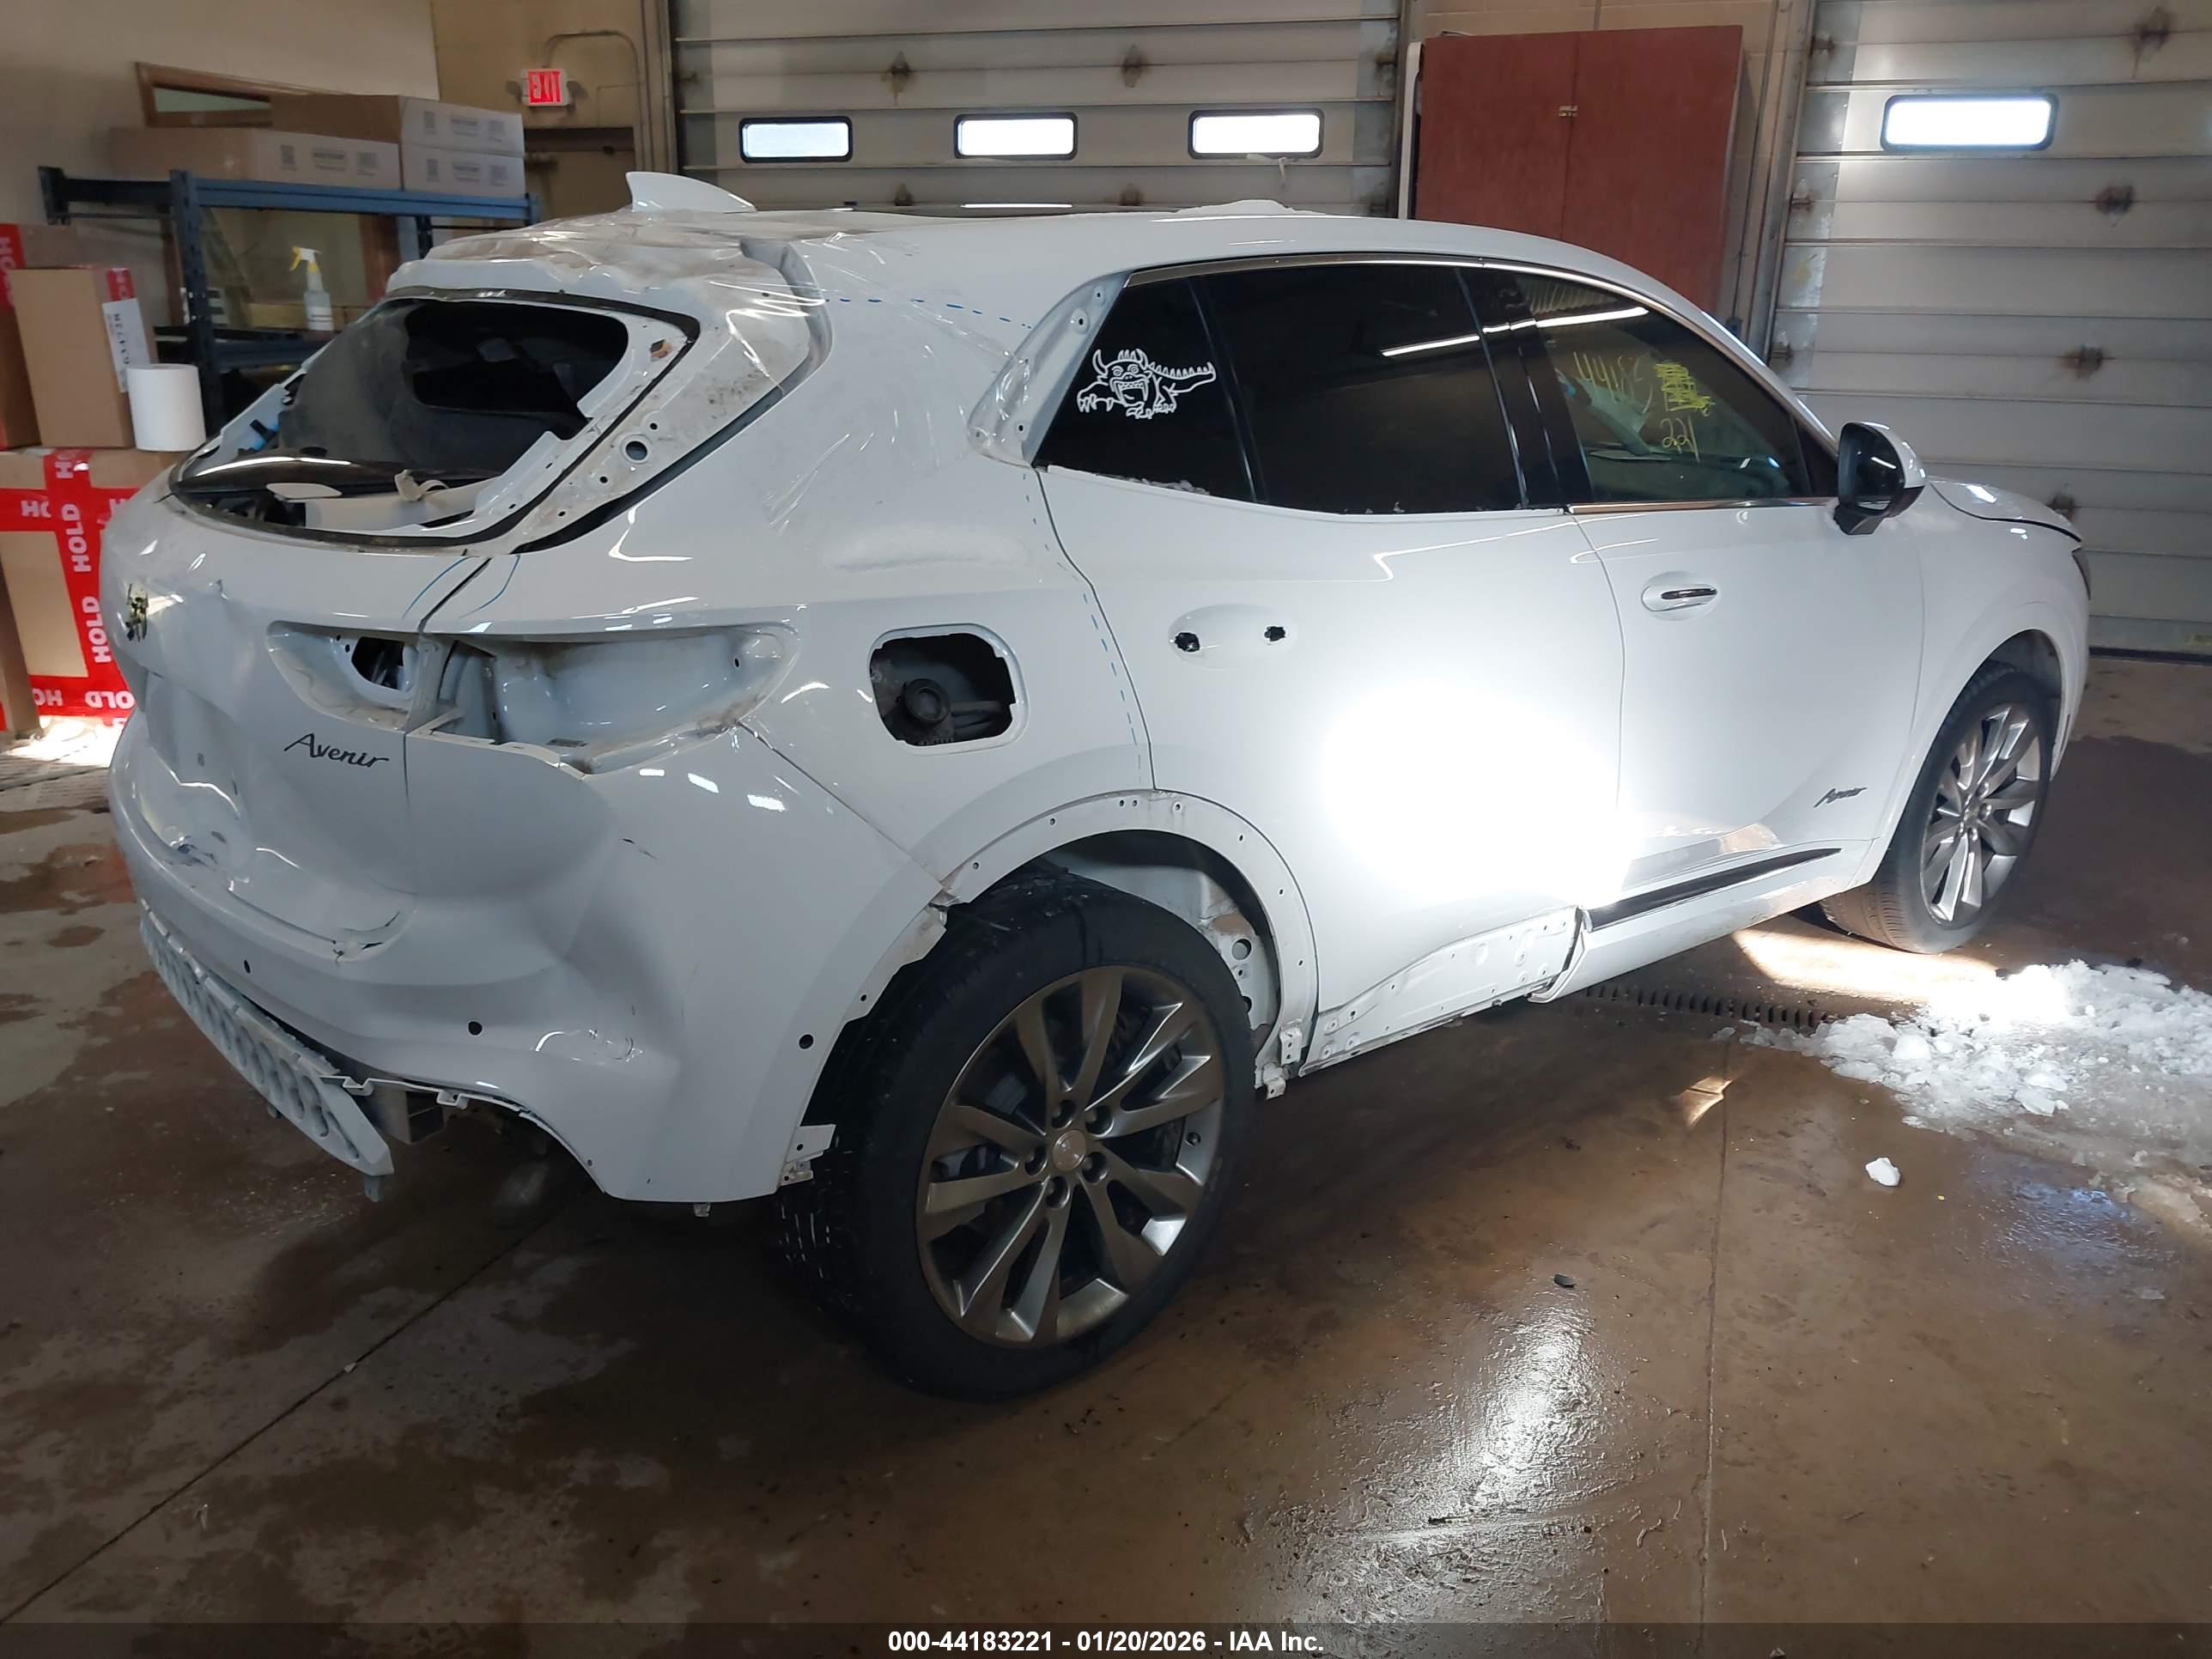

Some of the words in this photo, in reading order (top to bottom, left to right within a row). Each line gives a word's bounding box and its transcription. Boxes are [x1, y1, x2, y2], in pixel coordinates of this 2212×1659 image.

[528, 70, 561, 103] EXIT
[21, 500, 52, 518] HO
[61, 503, 92, 572] HOLD
[82, 596, 112, 663] HOLD
[84, 690, 135, 709] OLD
[283, 732, 390, 768] Avenir
